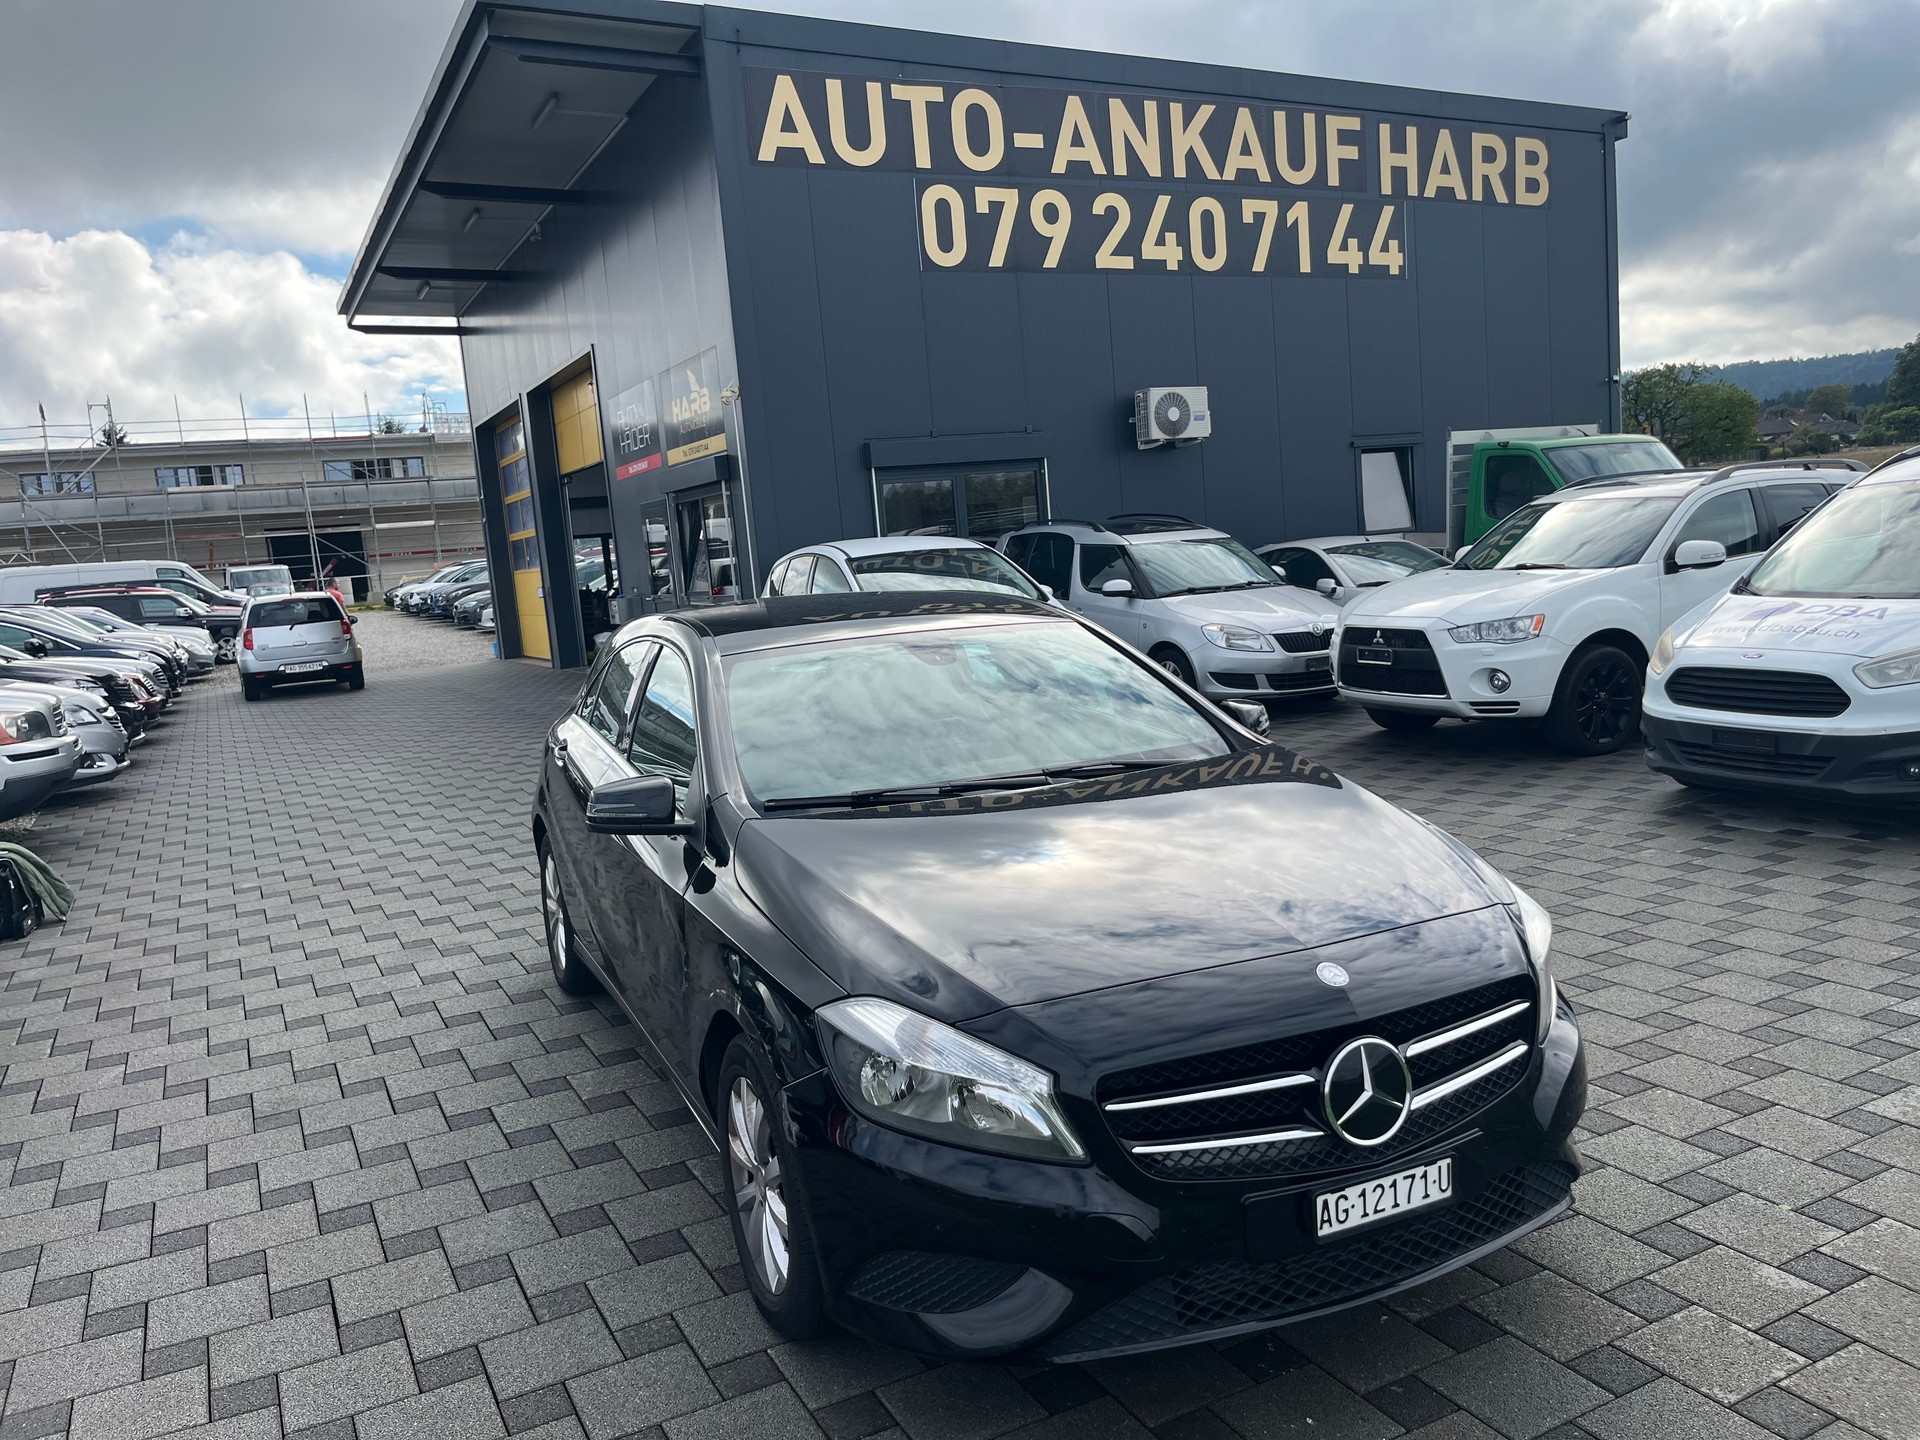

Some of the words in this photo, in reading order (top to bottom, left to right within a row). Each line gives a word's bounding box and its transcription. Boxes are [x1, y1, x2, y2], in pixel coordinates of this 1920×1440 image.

[757, 74, 1361, 187] AUTO-ANKAUF
[1378, 122, 1550, 207] HARB
[920, 183, 1072, 268] 079
[1093, 192, 1226, 272] 240
[672, 387, 711, 424] HARB
[1796, 604, 1888, 620] DBA
[1712, 623, 1860, 639] www.dbabau.ch
